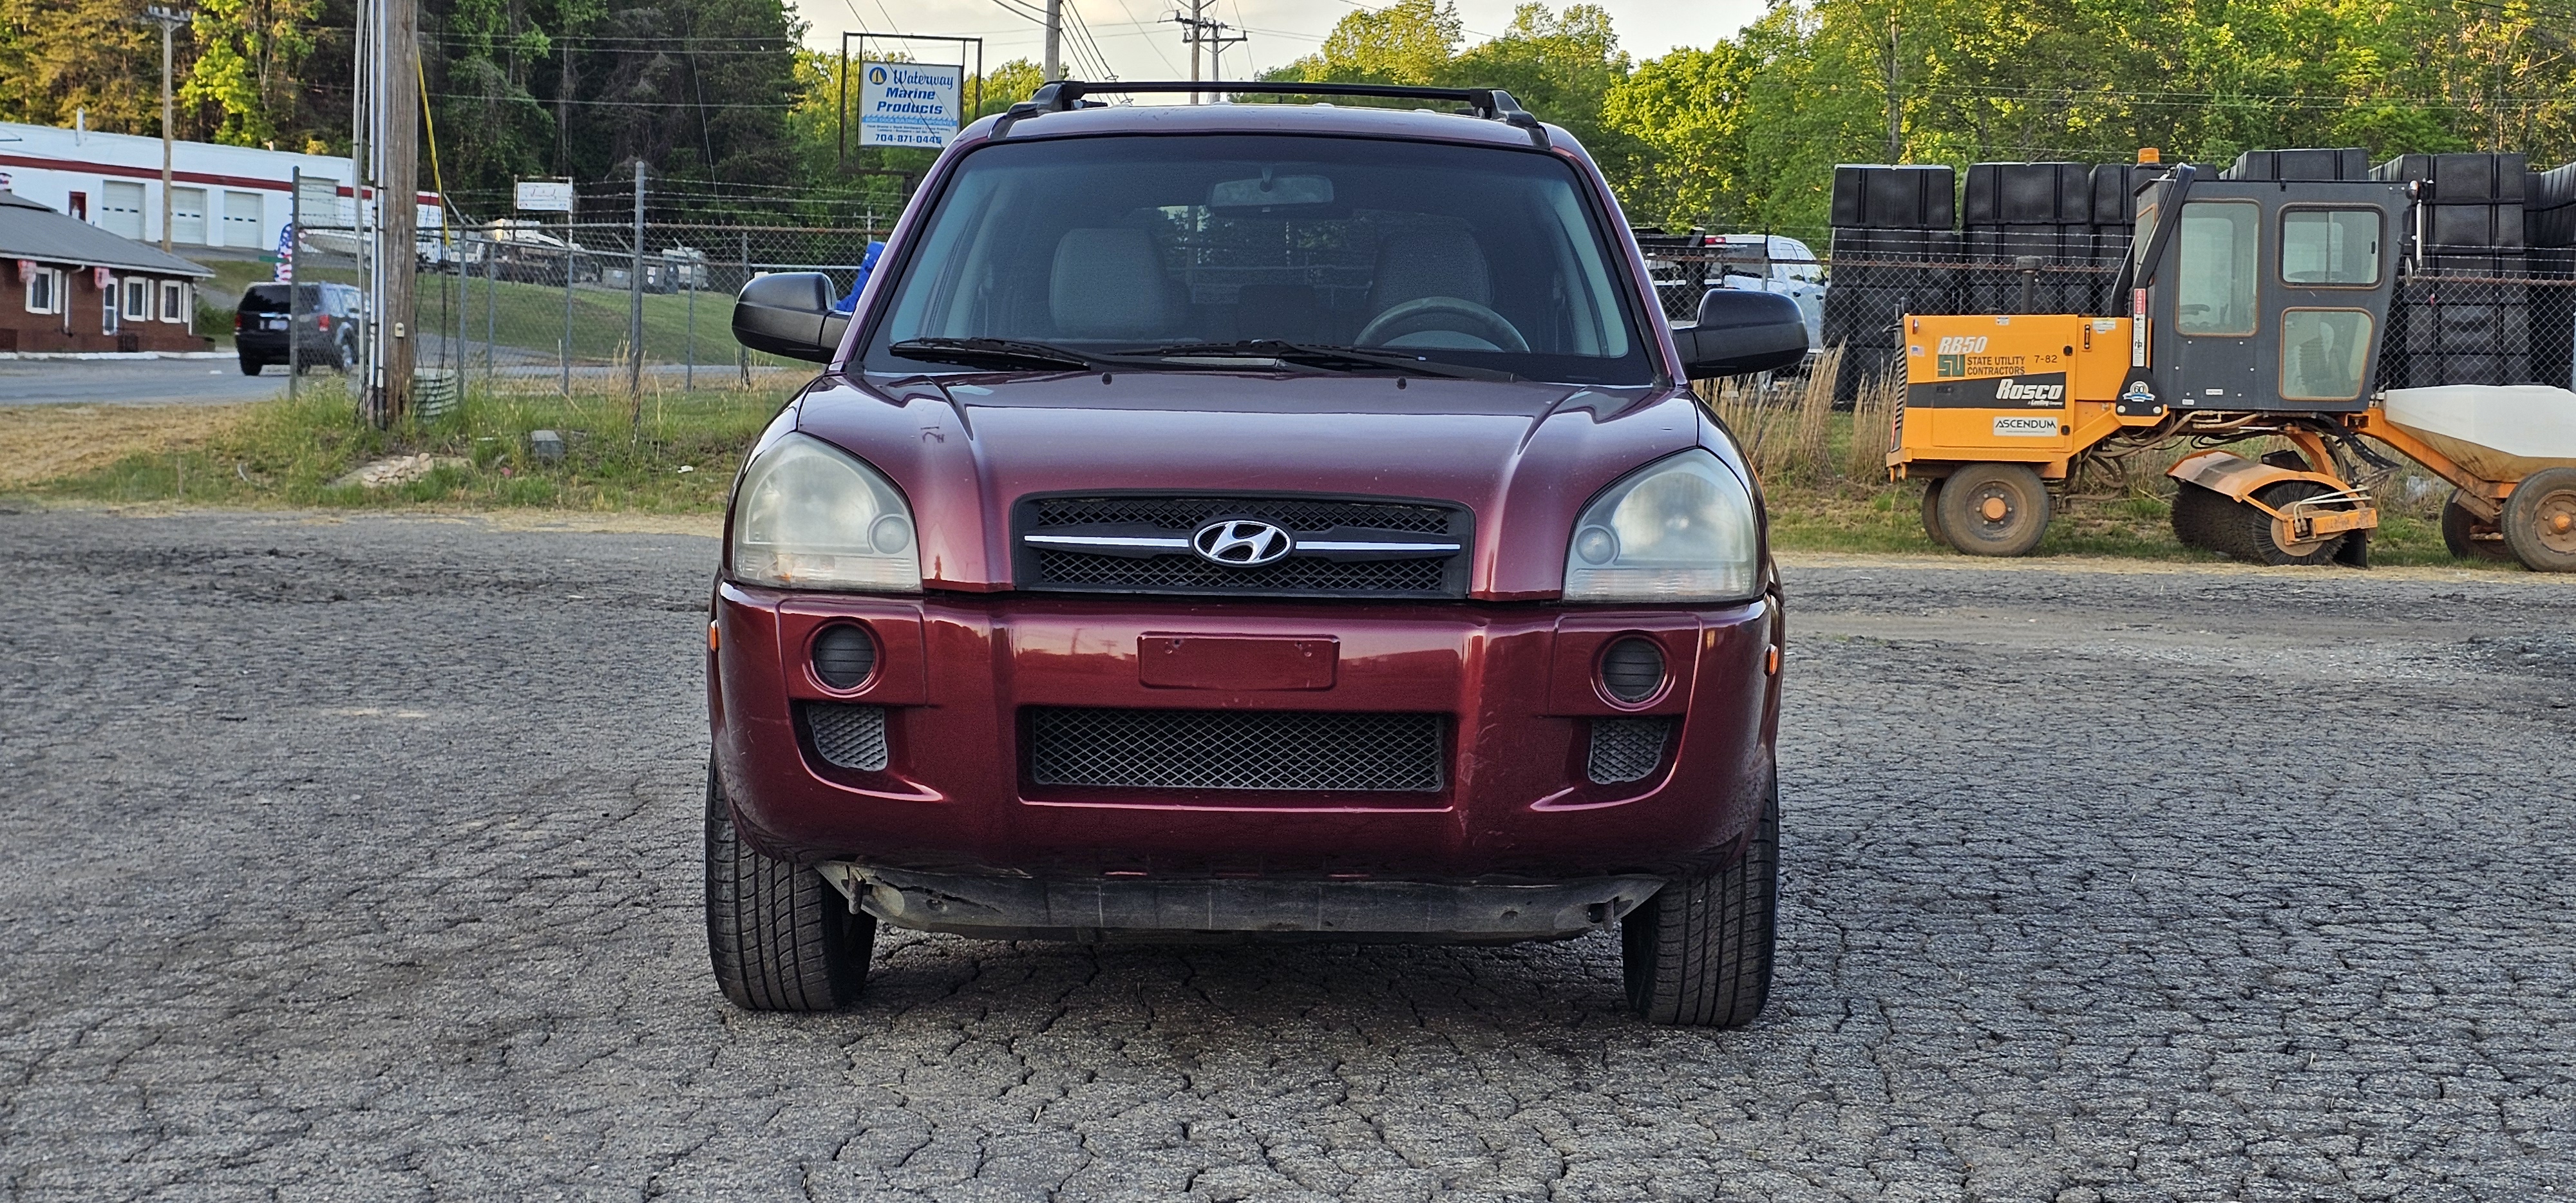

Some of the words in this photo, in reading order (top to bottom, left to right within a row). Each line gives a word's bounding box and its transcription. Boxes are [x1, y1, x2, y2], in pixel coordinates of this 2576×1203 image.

[894, 69, 954, 90] Waterway
[886, 87, 936, 100] Marine
[876, 101, 943, 114] Products
[1937, 336, 1988, 354] RB50
[1967, 356, 1992, 366] STATE
[1994, 355, 2025, 366] UTILITY
[2034, 355, 2058, 364] 7-82
[1967, 366, 2025, 375] CONTRACTORS
[1996, 379, 2063, 399] Rosco
[1995, 419, 2056, 429] ASCENDUM
